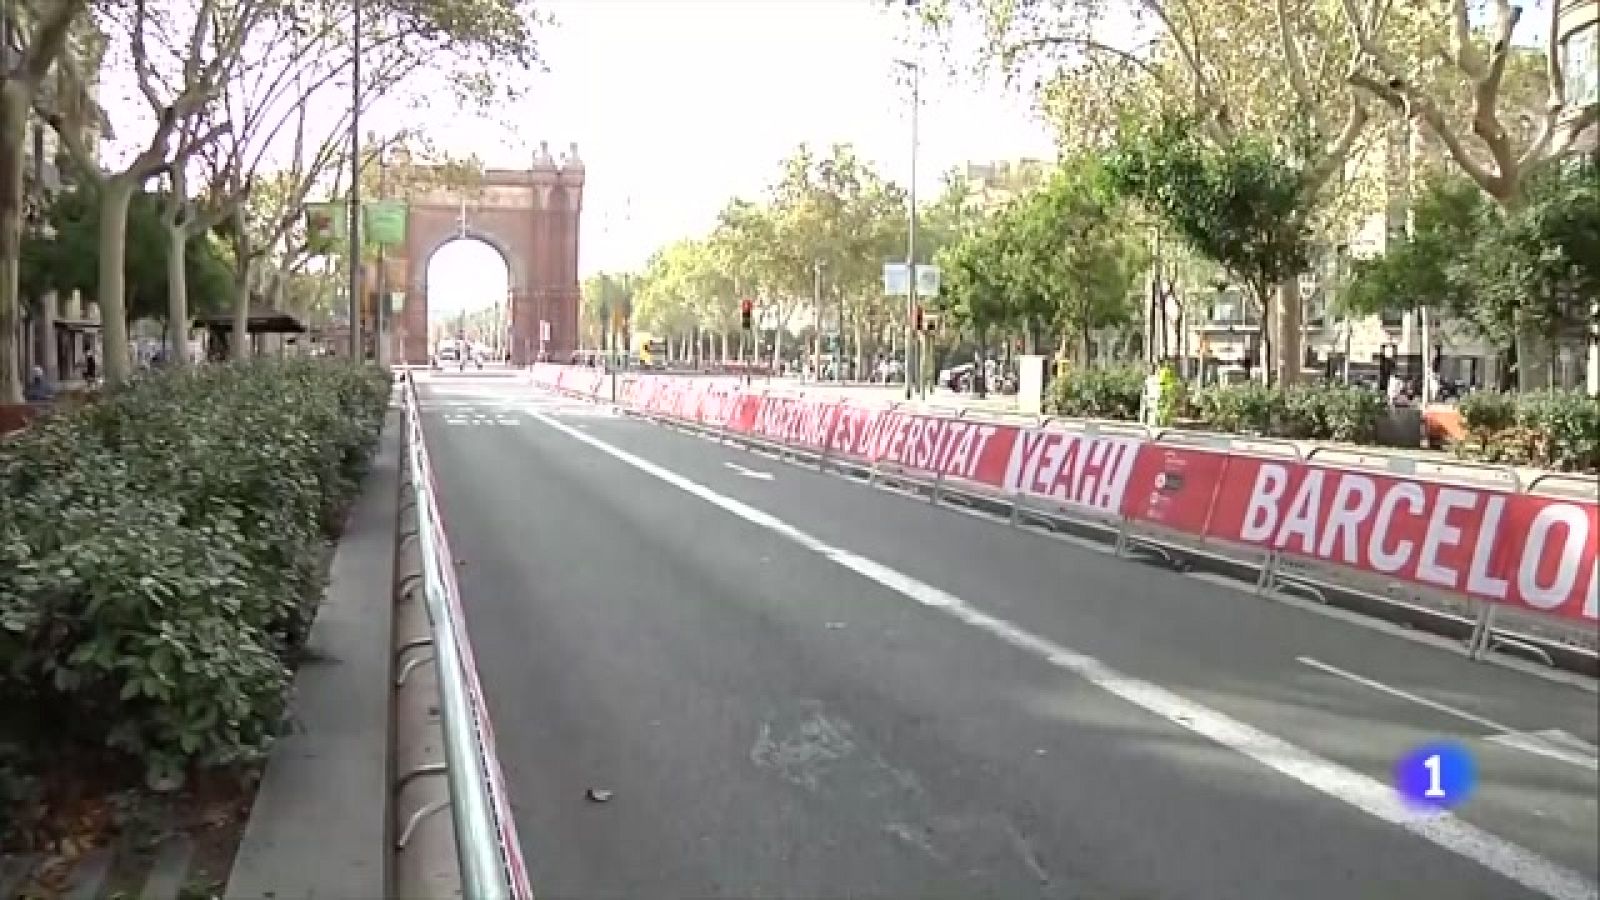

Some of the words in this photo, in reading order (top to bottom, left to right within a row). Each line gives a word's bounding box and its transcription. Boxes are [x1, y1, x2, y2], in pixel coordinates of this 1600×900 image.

[857, 407, 996, 477] DIVERSITAT
[1017, 427, 1128, 508] YEAH!
[1240, 463, 1598, 618] BARCELO
